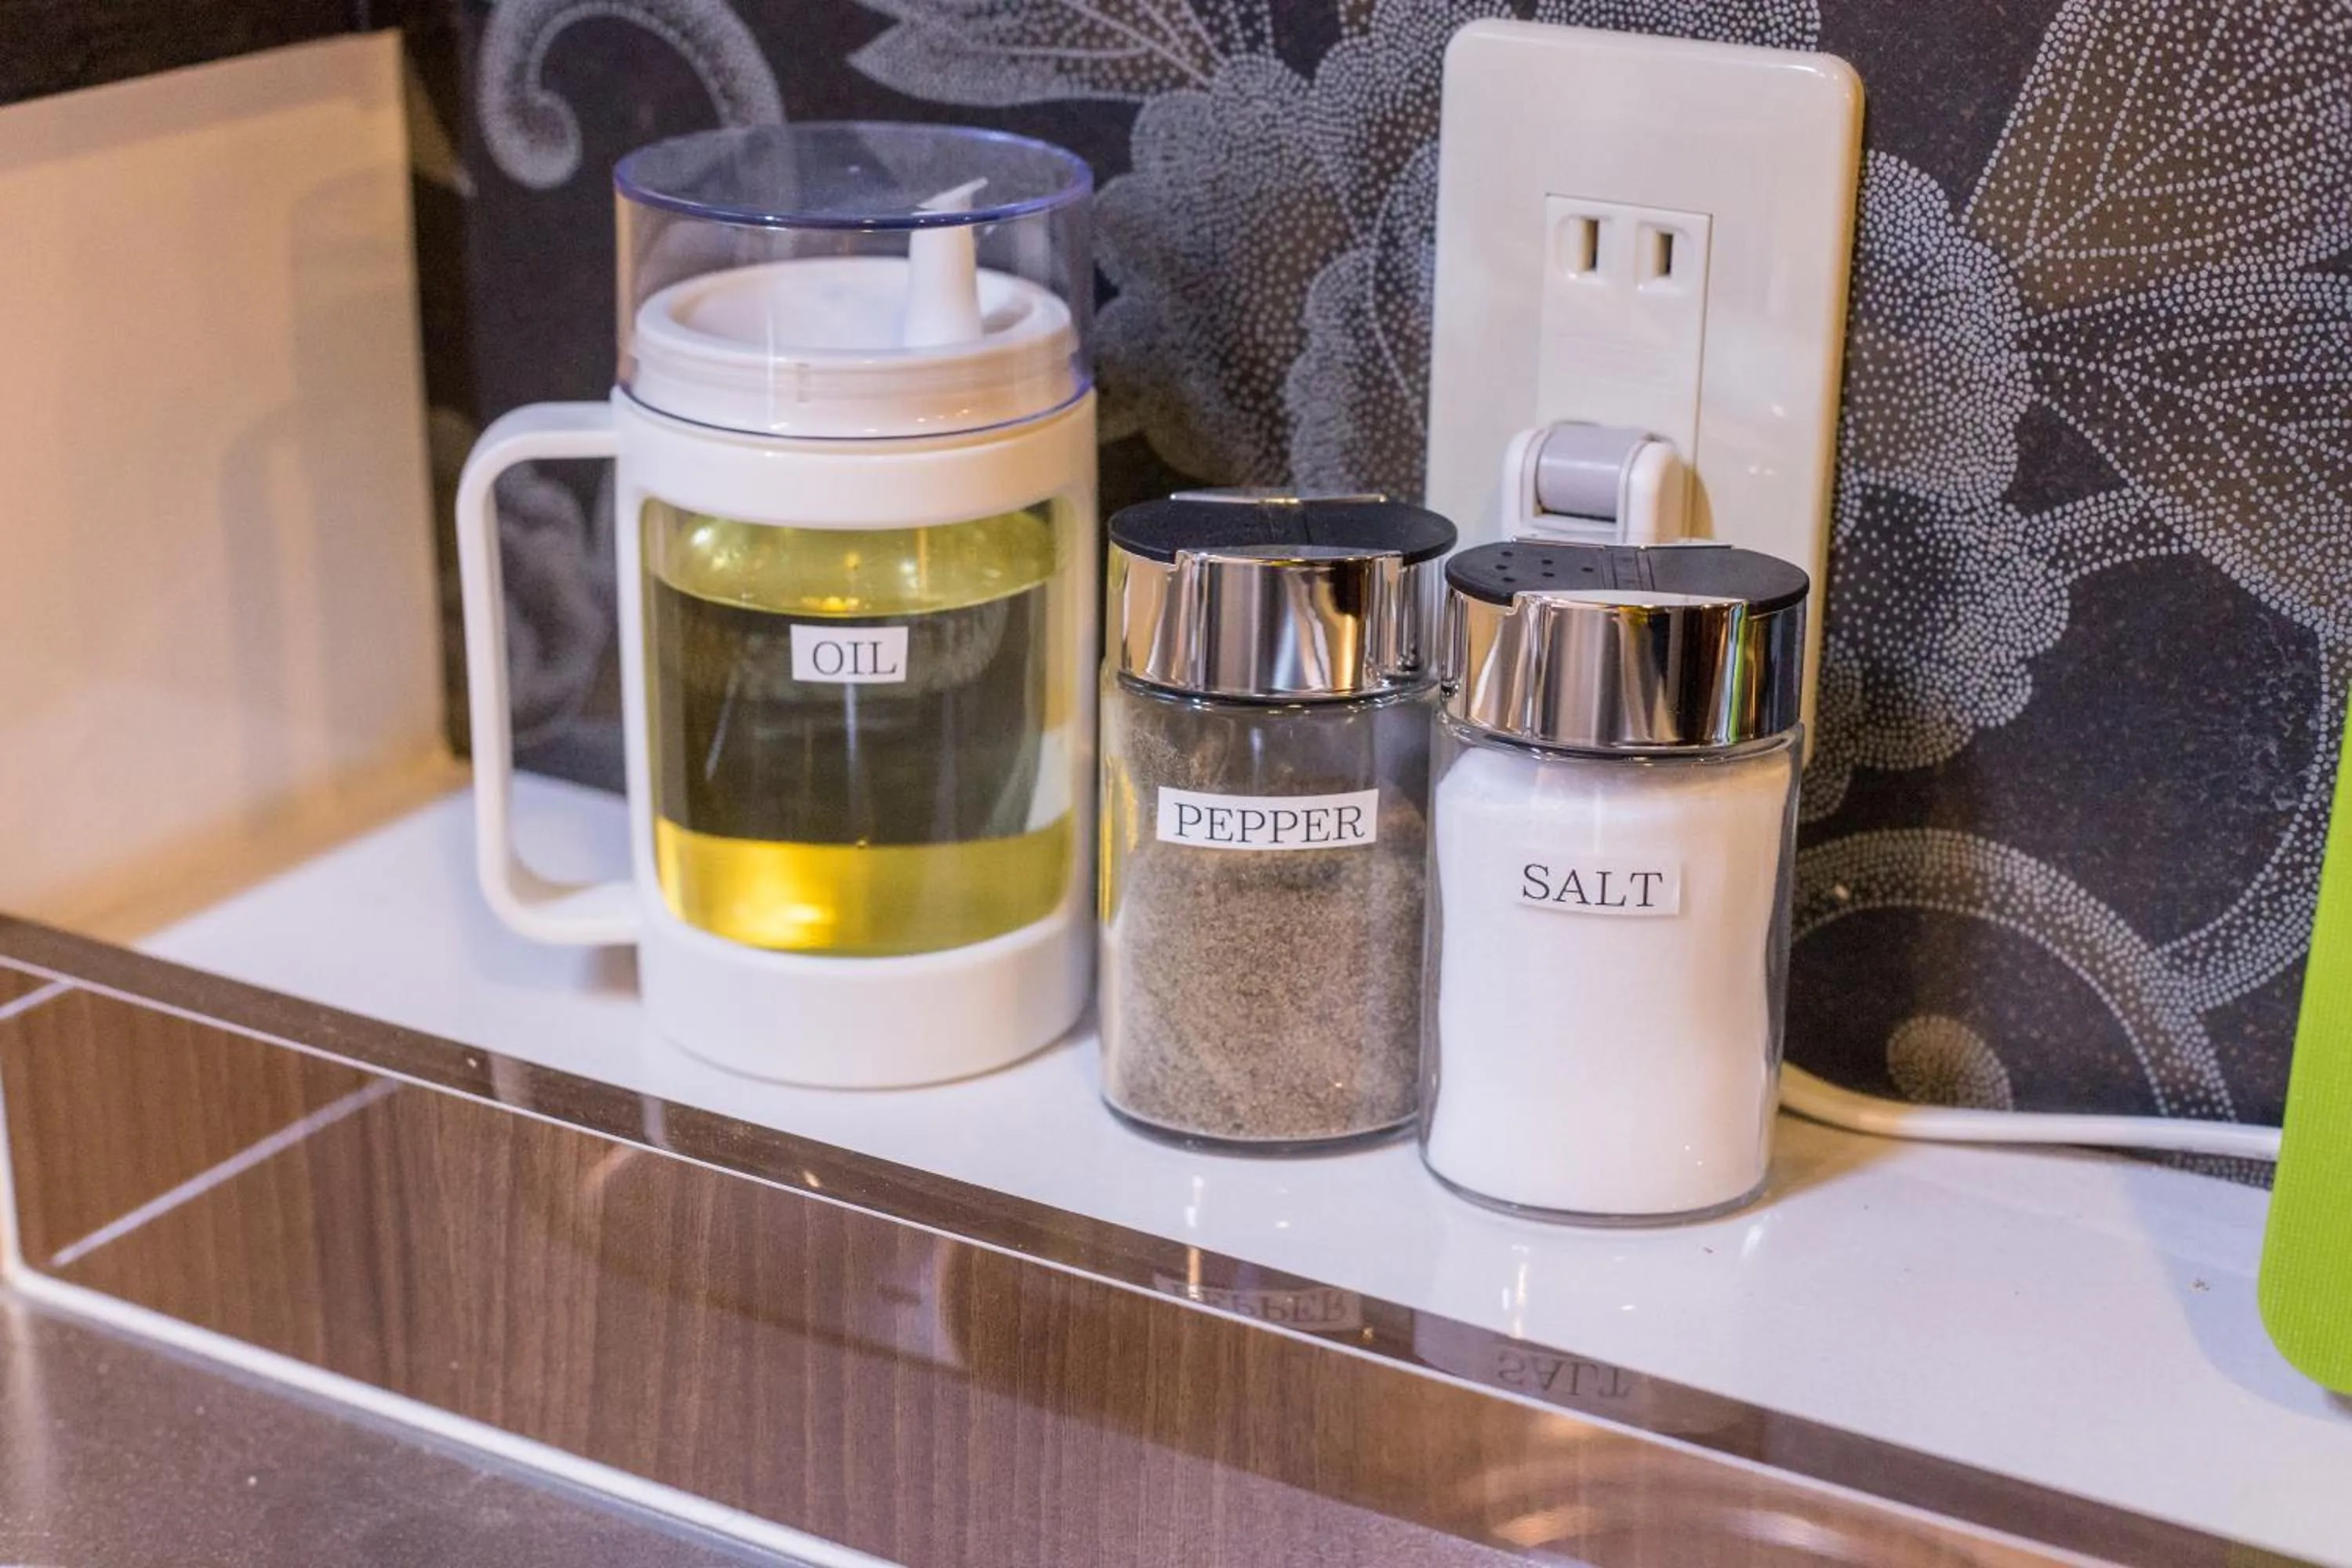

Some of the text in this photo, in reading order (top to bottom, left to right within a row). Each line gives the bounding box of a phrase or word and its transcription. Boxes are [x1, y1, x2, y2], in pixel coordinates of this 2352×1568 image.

[813, 641, 898, 675] OIL
[1174, 802, 1365, 844] PEPPER
[1523, 863, 1663, 907] SALT
